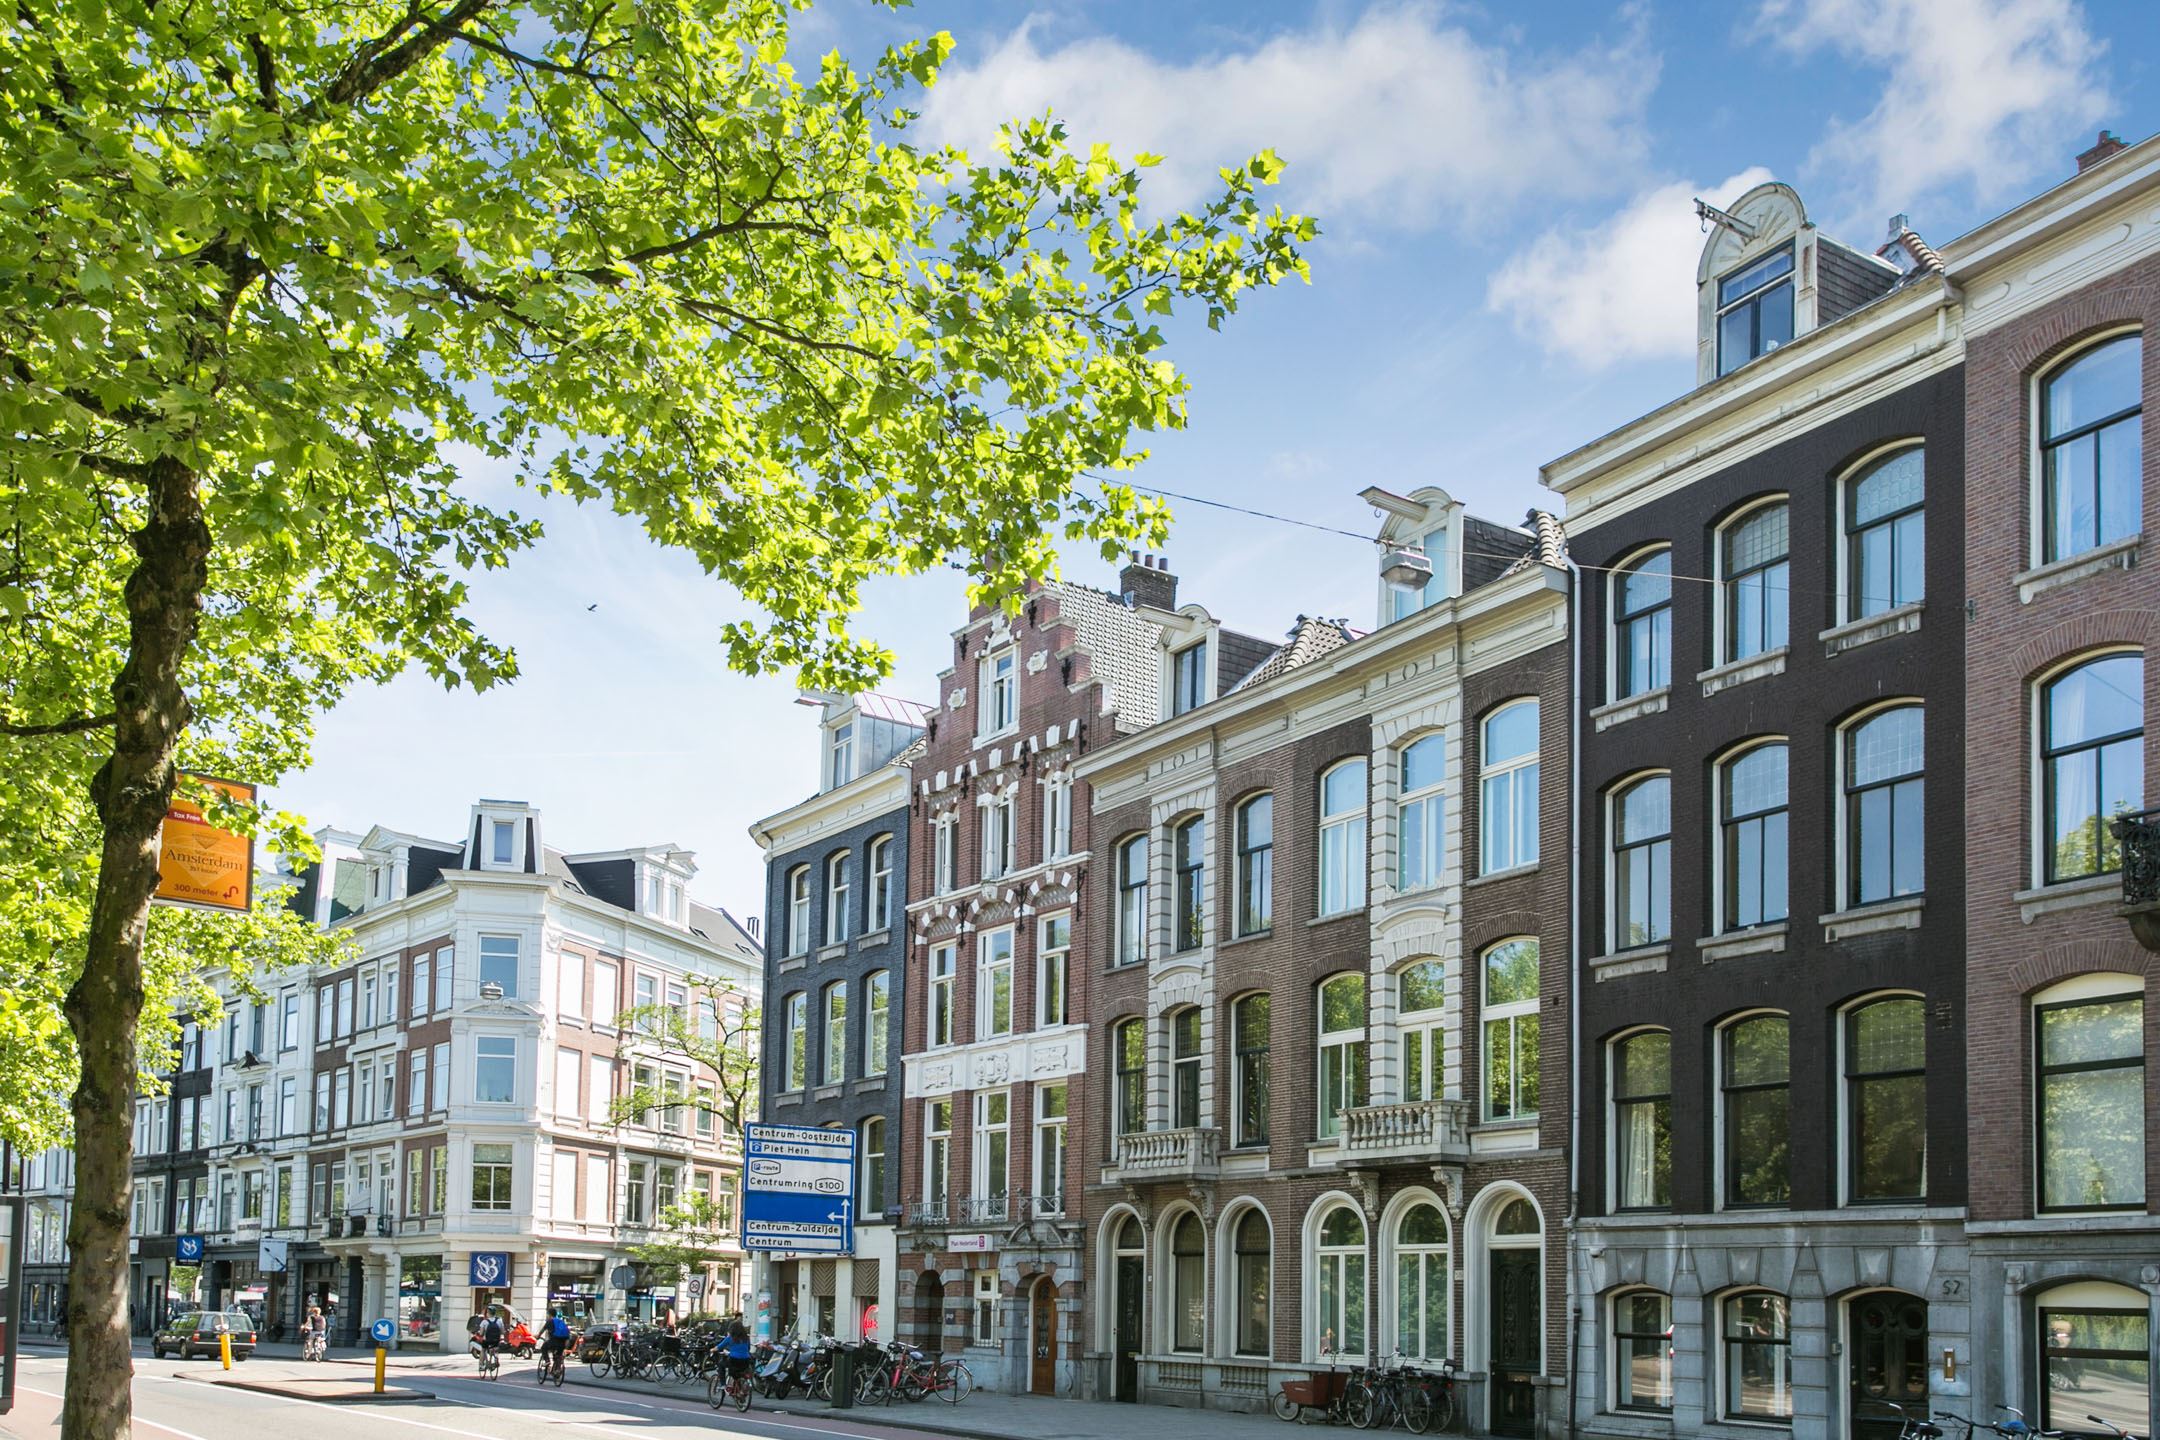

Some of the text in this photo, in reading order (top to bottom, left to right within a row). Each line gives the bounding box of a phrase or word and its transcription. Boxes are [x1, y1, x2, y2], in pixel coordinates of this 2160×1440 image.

[165, 849, 242, 871] Amsterdam
[192, 887, 218, 896] meter
[752, 1128, 846, 1144] Centrum-Oostzijde
[764, 1144, 783, 1153] Piet
[788, 1146, 810, 1155] Hein
[750, 1177, 840, 1190] Centrumring s100
[749, 1222, 839, 1235] Centrum-Zuidzijde
[748, 1237, 792, 1246] Centrum
